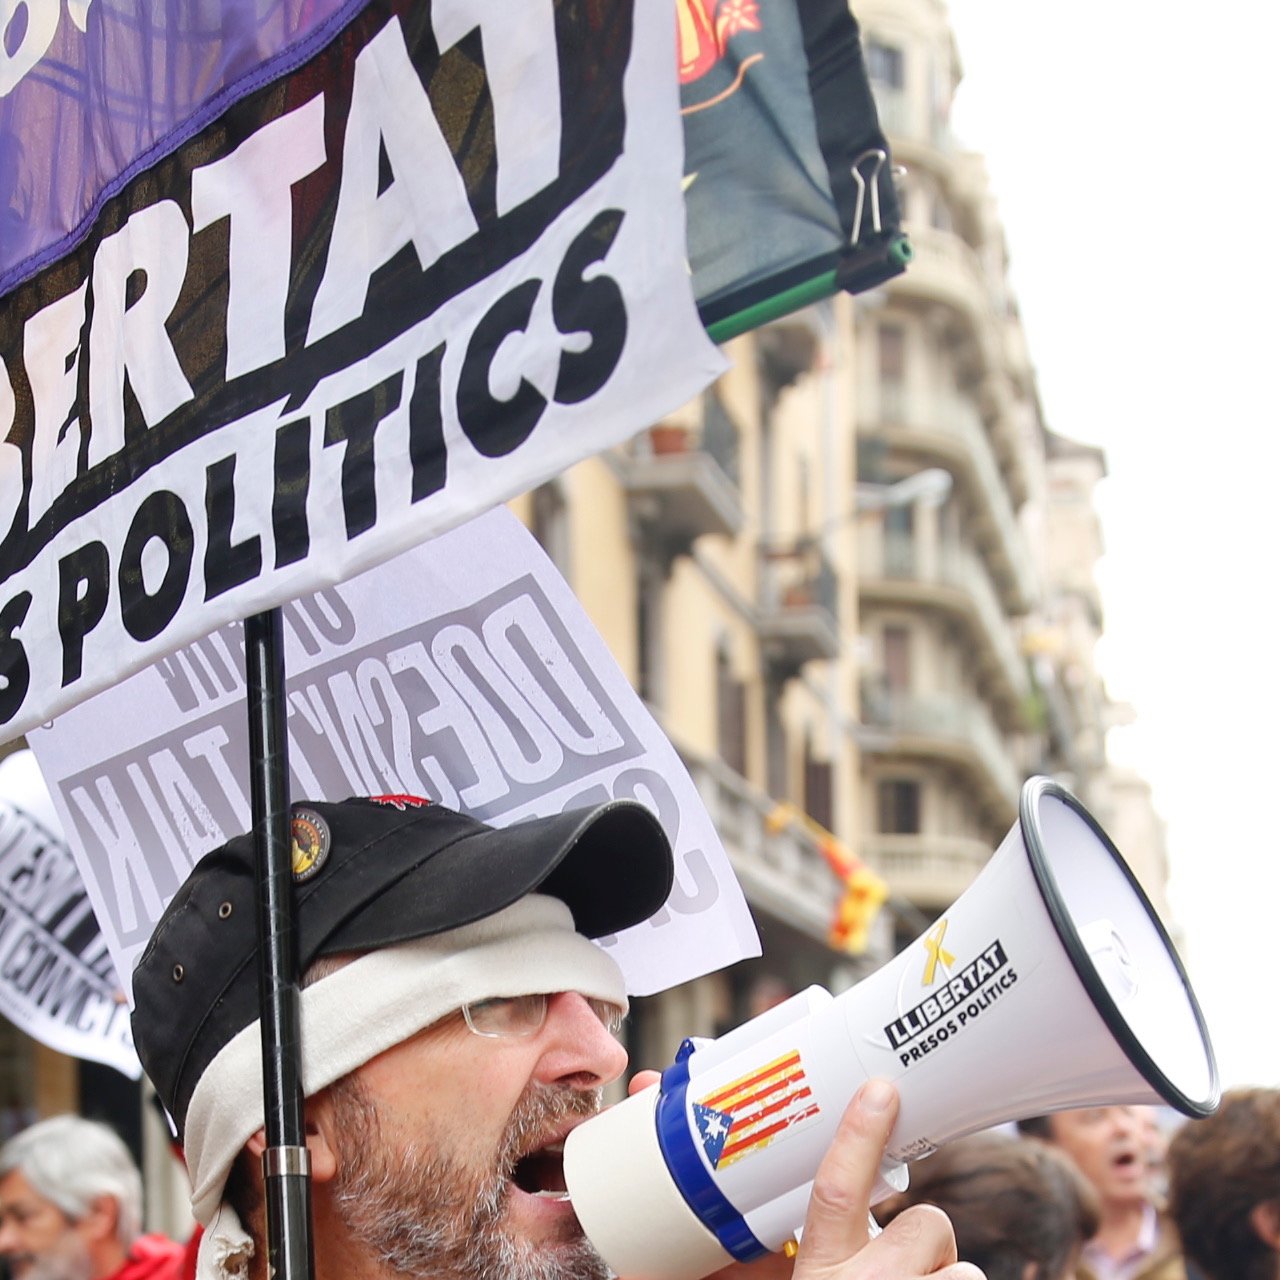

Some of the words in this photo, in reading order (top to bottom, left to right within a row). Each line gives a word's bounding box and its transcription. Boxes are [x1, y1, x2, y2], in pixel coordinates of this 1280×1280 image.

[58, 208, 629, 686] POLÍTICS
[0, 930, 137, 1048] CONVICT
[890, 946, 1000, 1045] LLIBERTAT
[900, 1020, 958, 1067] PRESOS
[957, 969, 1017, 1026] POLÍTICS
